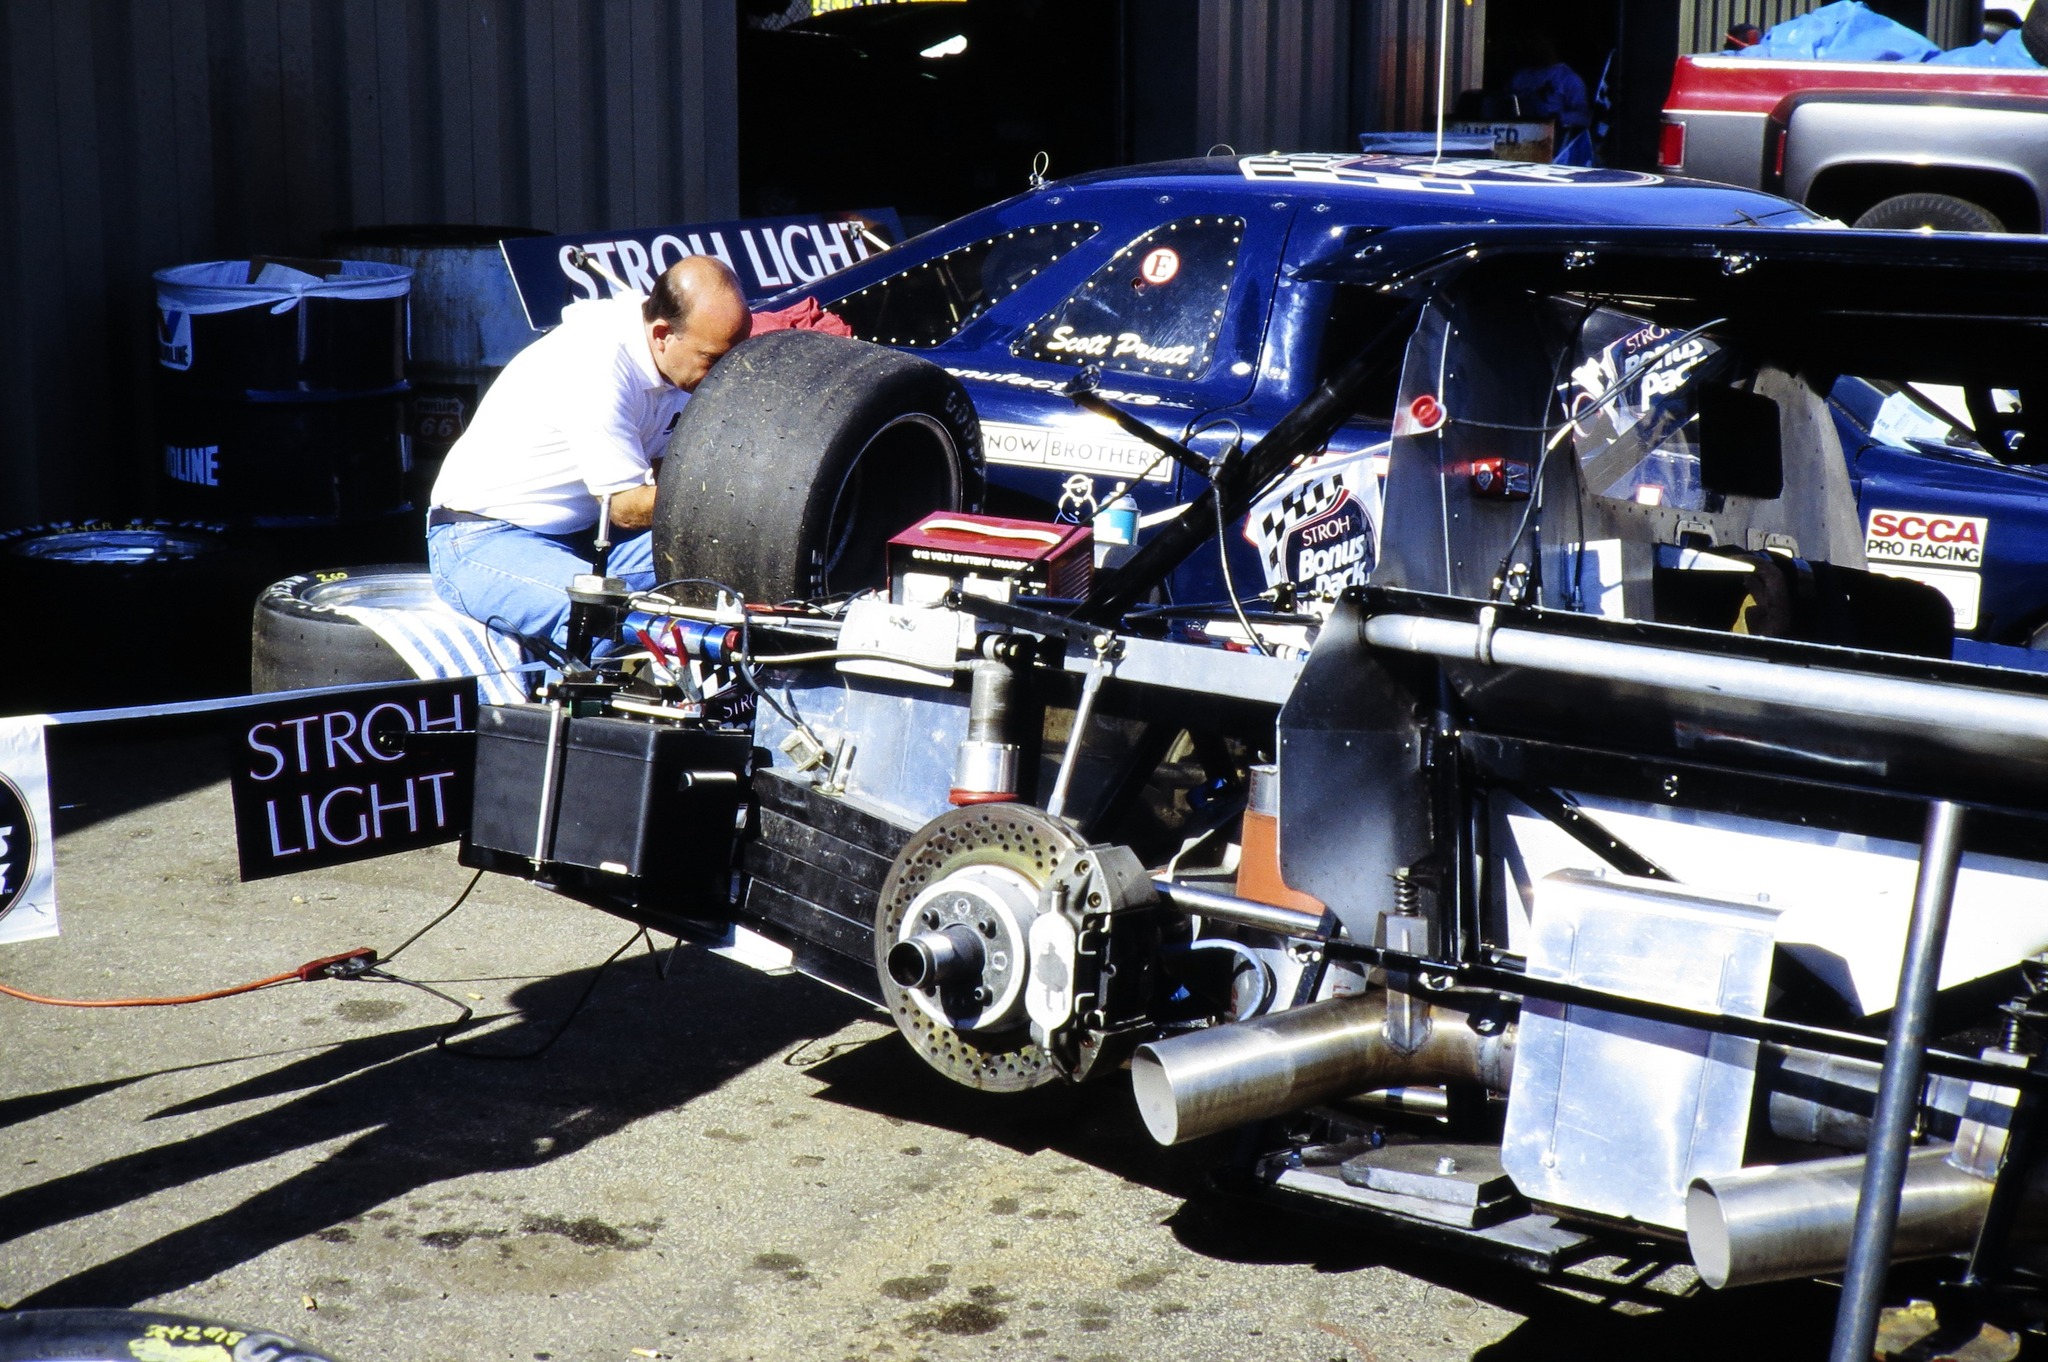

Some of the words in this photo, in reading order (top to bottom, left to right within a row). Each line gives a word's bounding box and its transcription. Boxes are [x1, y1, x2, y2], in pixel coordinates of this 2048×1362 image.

[740, 220, 866, 288] LIGHT
[1150, 254, 1171, 277] E
[1047, 326, 1112, 355] Scott
[1112, 333, 1195, 365] Pruett
[1626, 324, 1674, 354] STRO
[421, 418, 454, 437] 66
[982, 432, 1042, 453] NOW
[1051, 440, 1163, 469] BROTHERS
[1302, 515, 1351, 547] STROH
[1871, 513, 1980, 545] SCCA
[1298, 534, 1366, 583] Bonus
[1867, 539, 1905, 556] PRO
[1910, 543, 1980, 563] RACING
[248, 694, 463, 781] STROH
[266, 771, 454, 857] LIGHT
